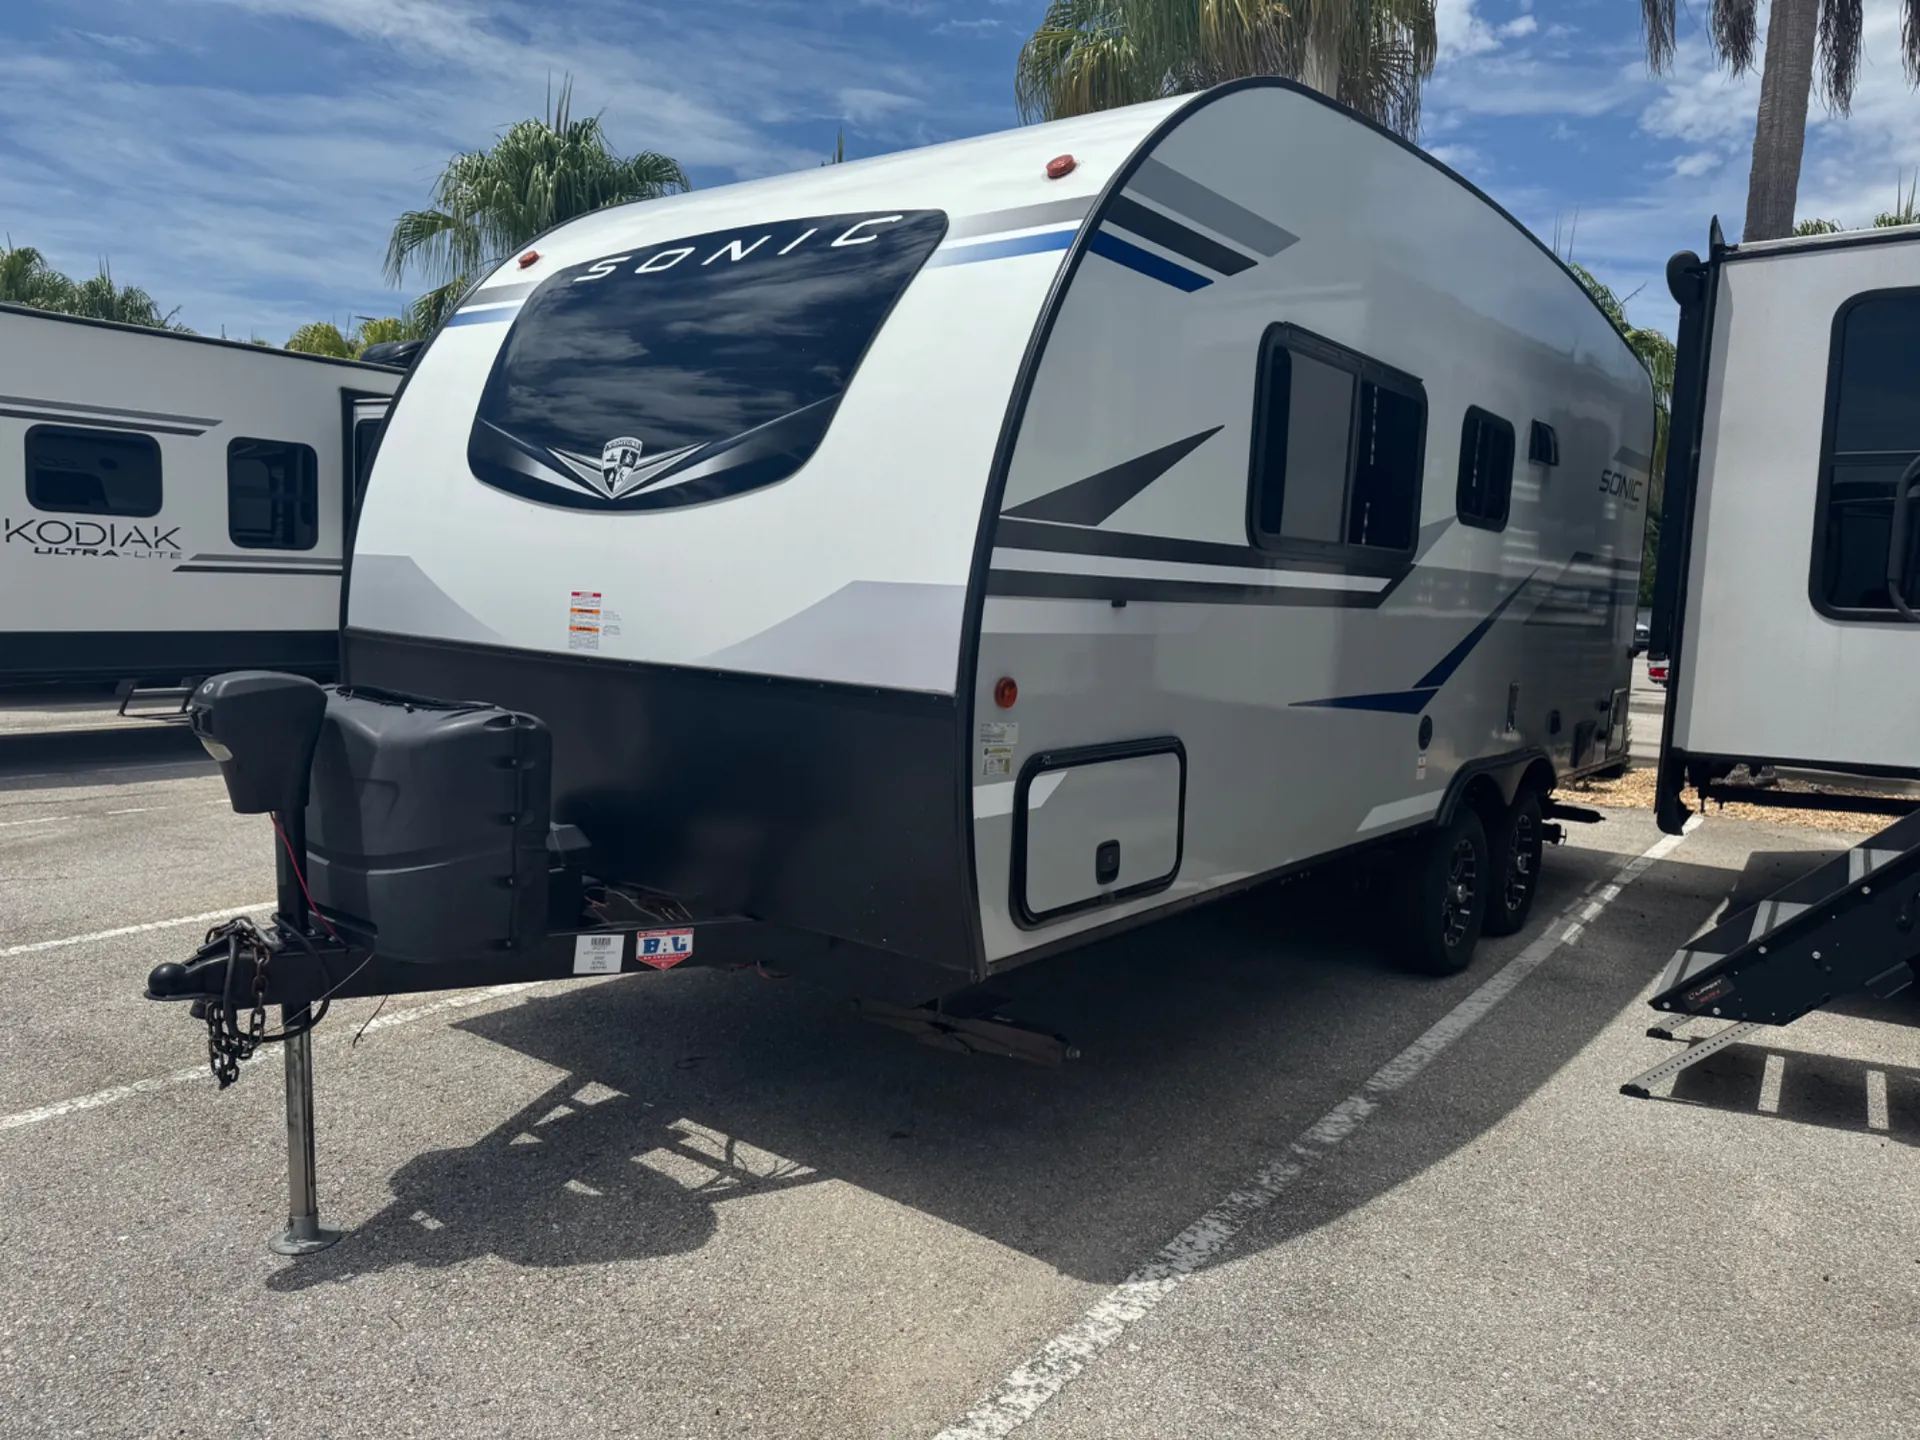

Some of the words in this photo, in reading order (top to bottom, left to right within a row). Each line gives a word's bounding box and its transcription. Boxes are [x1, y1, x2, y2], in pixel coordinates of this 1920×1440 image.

[573, 214, 903, 283] SONIC
[1598, 468, 1643, 502] SONIC
[5, 517, 182, 550] KODIAK
[34, 546, 183, 560] ULTRA-LITE
